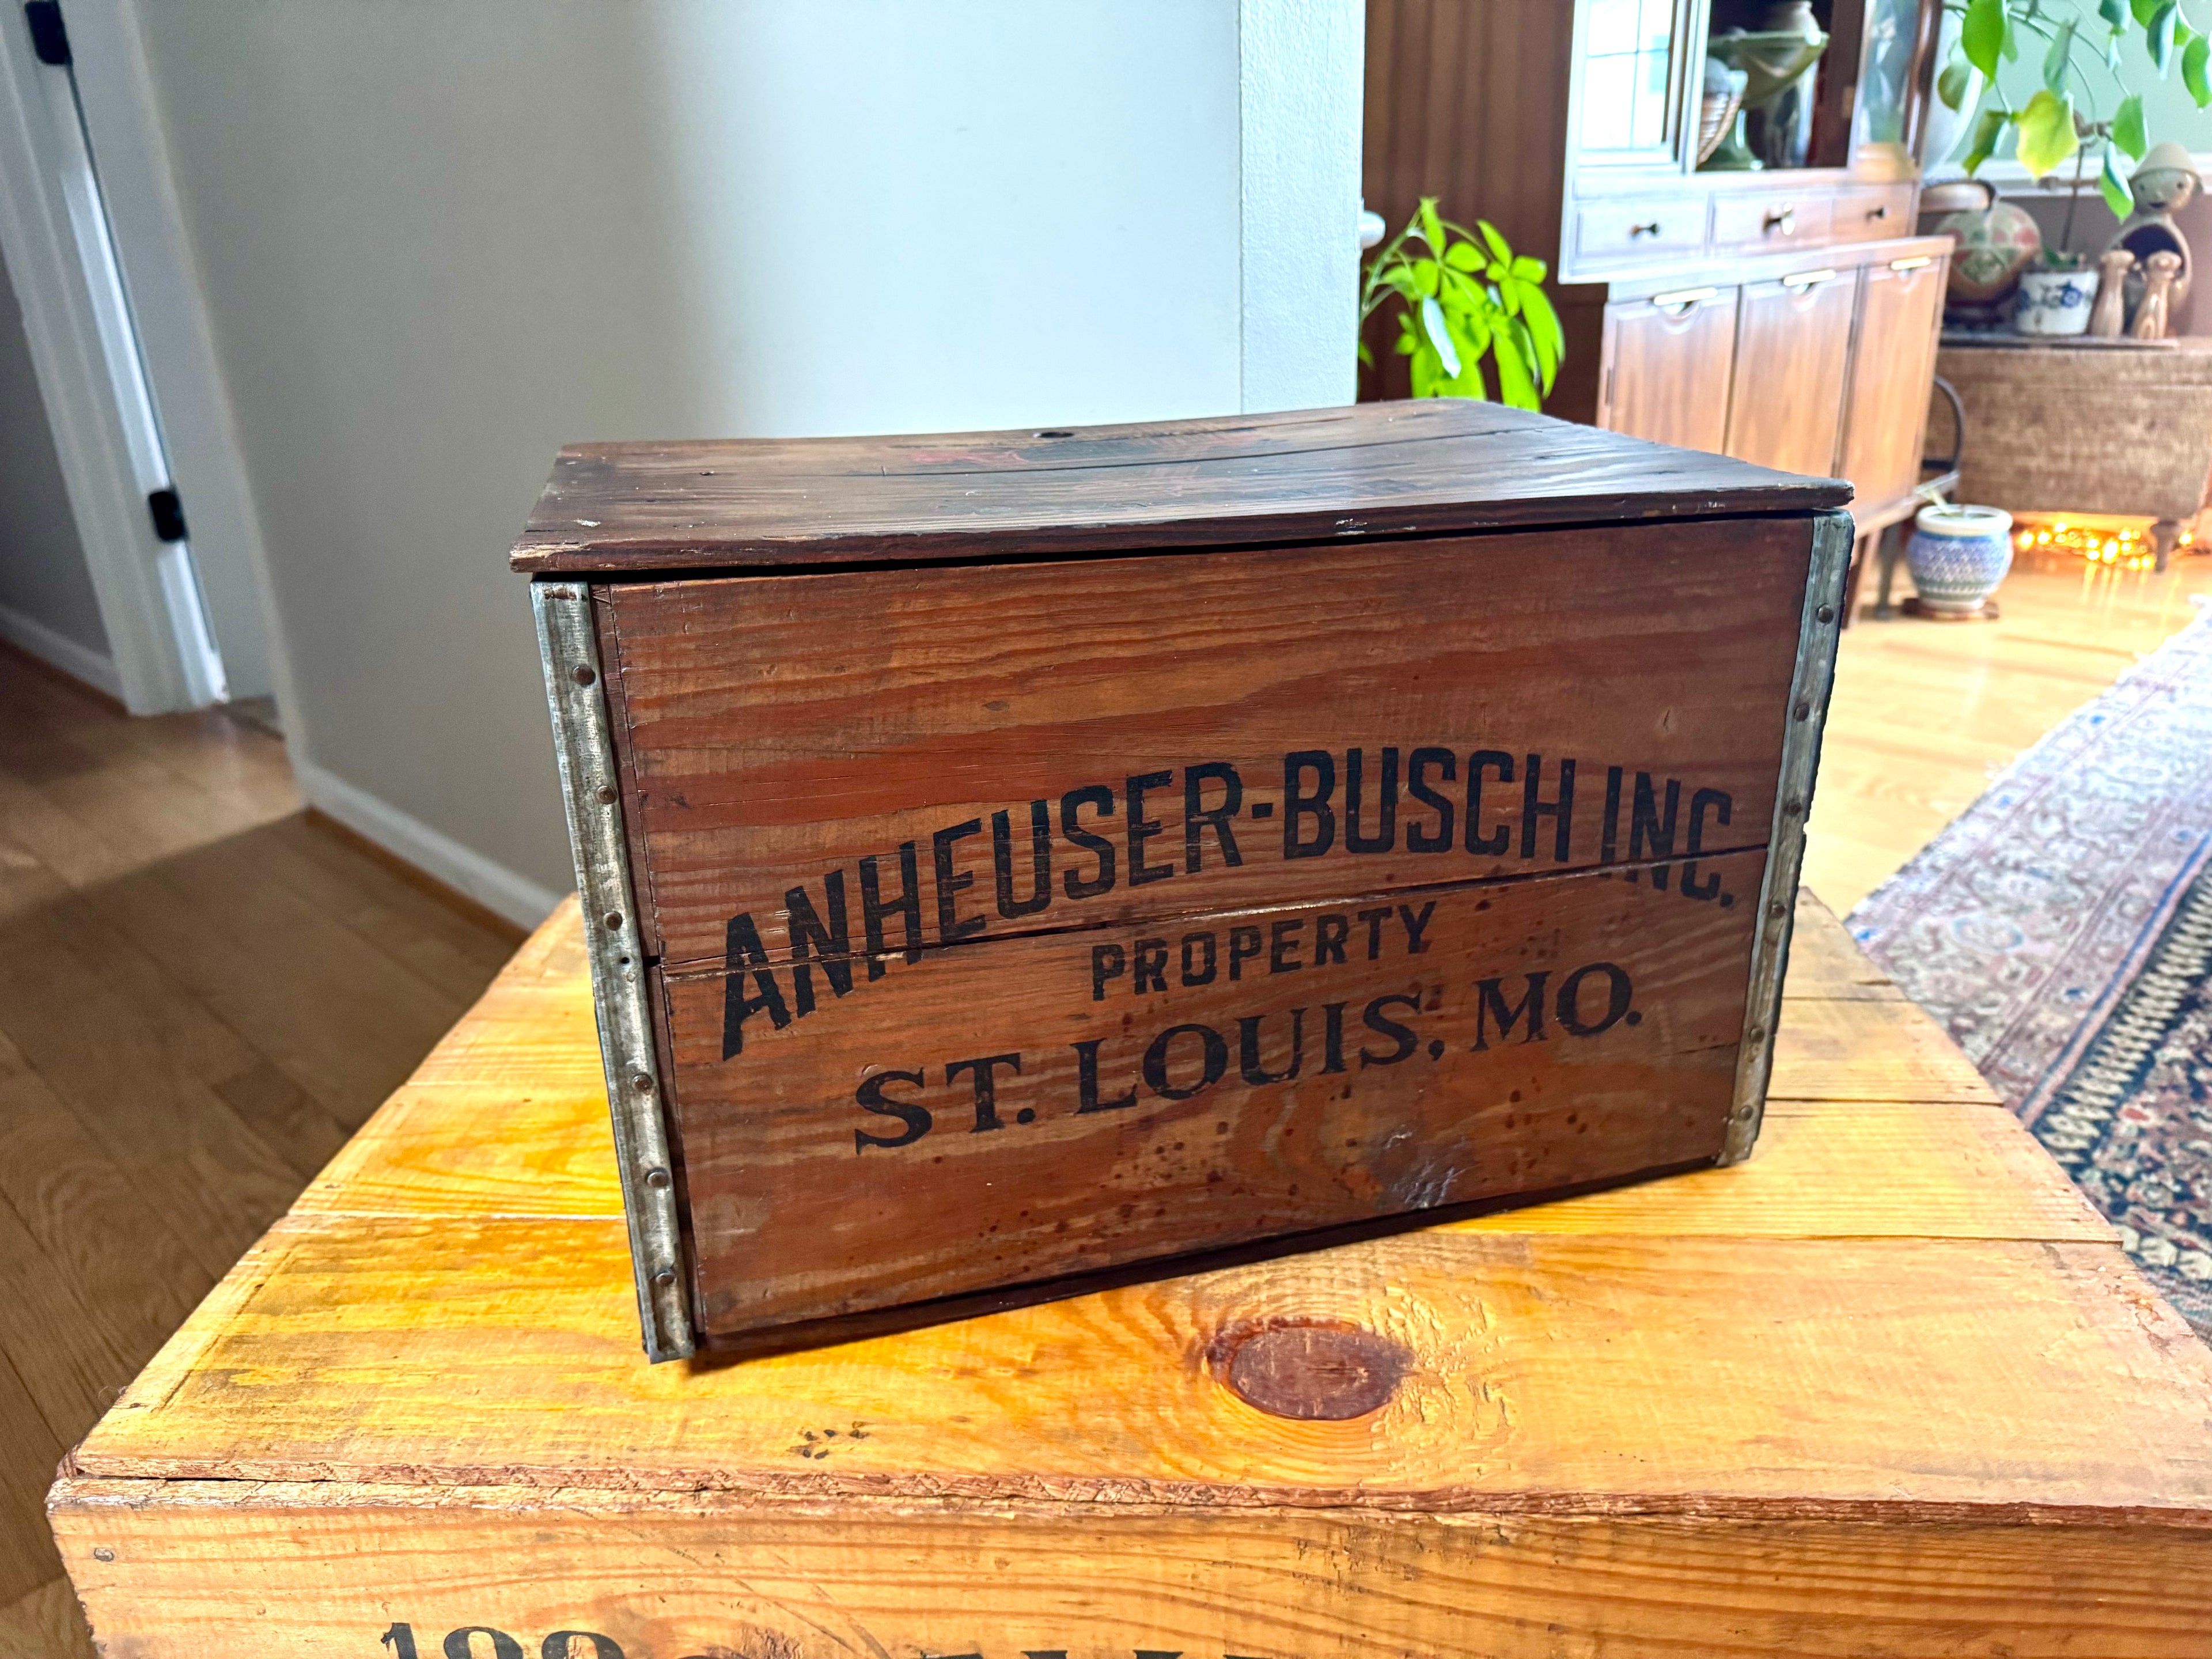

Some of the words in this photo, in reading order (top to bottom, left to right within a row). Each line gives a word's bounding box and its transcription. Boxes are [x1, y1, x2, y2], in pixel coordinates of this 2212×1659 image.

[722, 746, 1575, 1062] ANHEUSER-BUSCH
[1599, 766, 1734, 907] INC.
[1092, 901, 1436, 1001] PROPERTY
[854, 1052, 1036, 1154] ST.
[1070, 994, 1445, 1115] LOUIS,
[1469, 961, 1642, 1053] MO.
